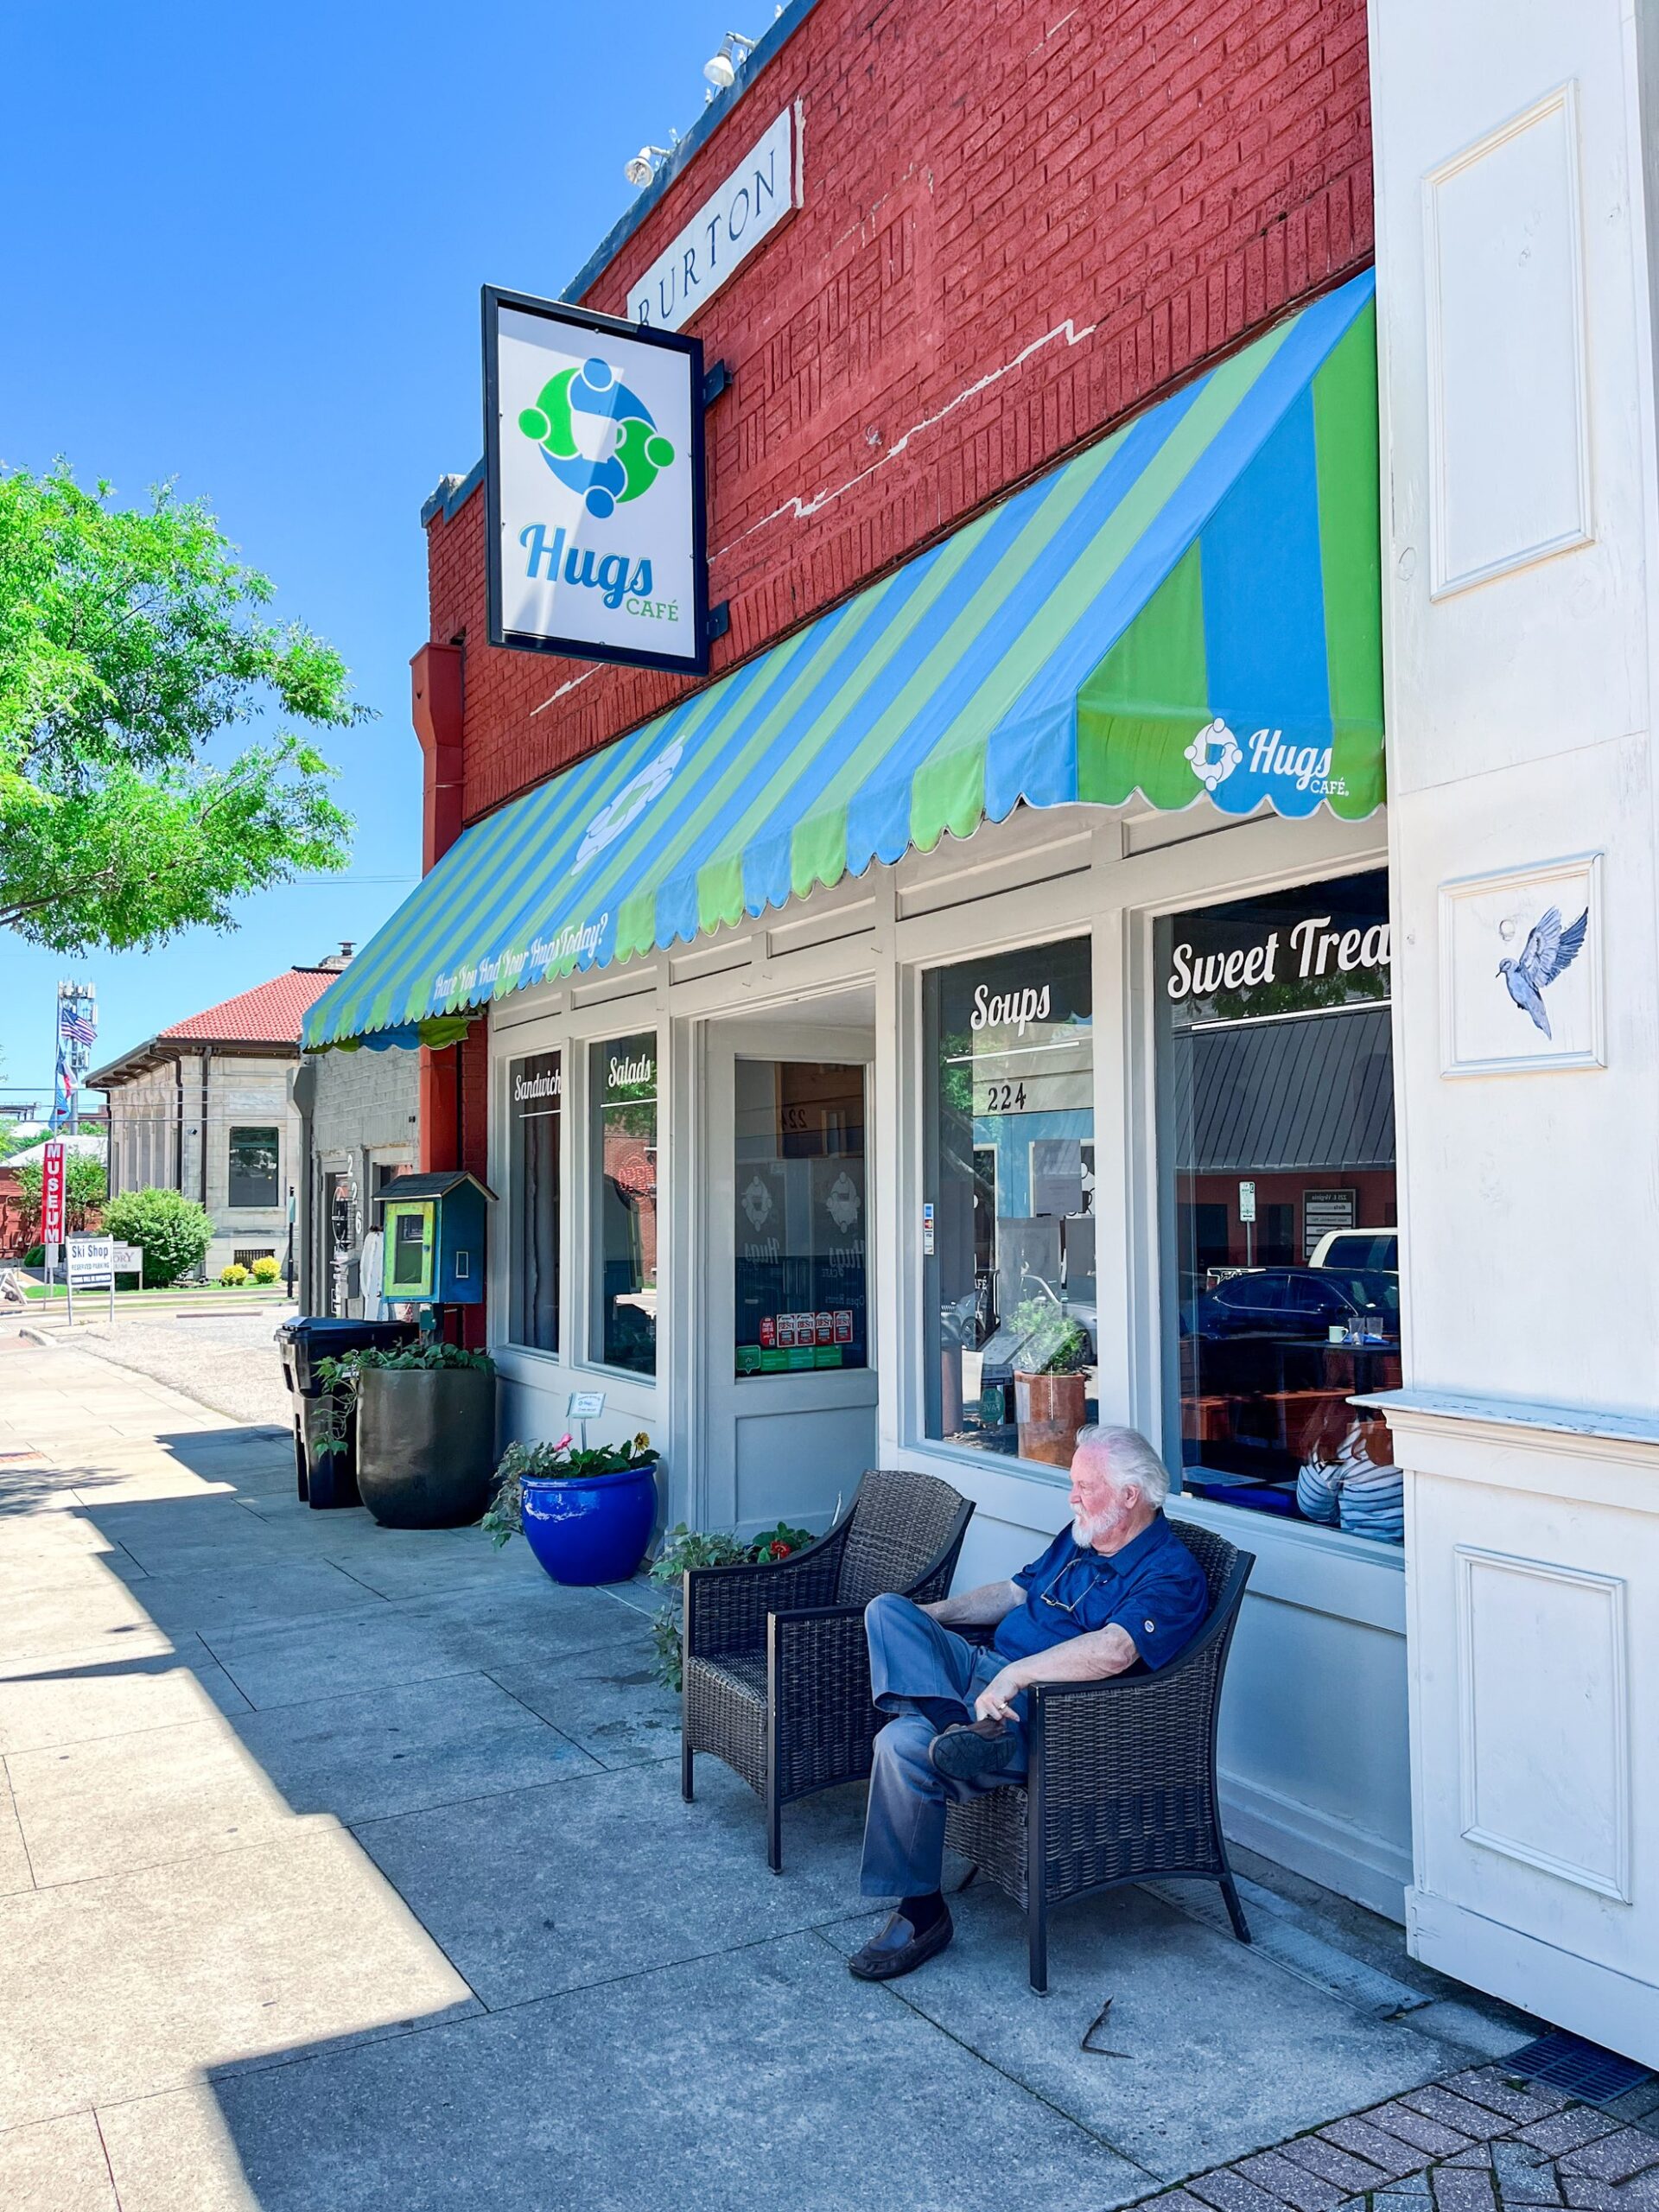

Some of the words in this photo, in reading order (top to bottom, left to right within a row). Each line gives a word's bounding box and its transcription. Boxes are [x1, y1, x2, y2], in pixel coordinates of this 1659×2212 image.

[518, 522, 653, 609] Hugs
[626, 598, 679, 622] CAFÉ
[1249, 728, 1333, 791] Hugs
[433, 973, 457, 1000] Have
[458, 963, 477, 994] You
[479, 951, 503, 988] Had
[502, 948, 530, 978] Your
[528, 937, 560, 974] Hugs
[560, 912, 608, 958] Today?
[1167, 932, 1280, 999] Sweet
[970, 984, 1051, 1038] Soups
[608, 1053, 651, 1087] Salads
[988, 1082, 1027, 1112] 224
[44, 1145, 60, 1243] MUSEUM
[72, 1245, 85, 1258] Ski
[88, 1245, 109, 1259] Shop
